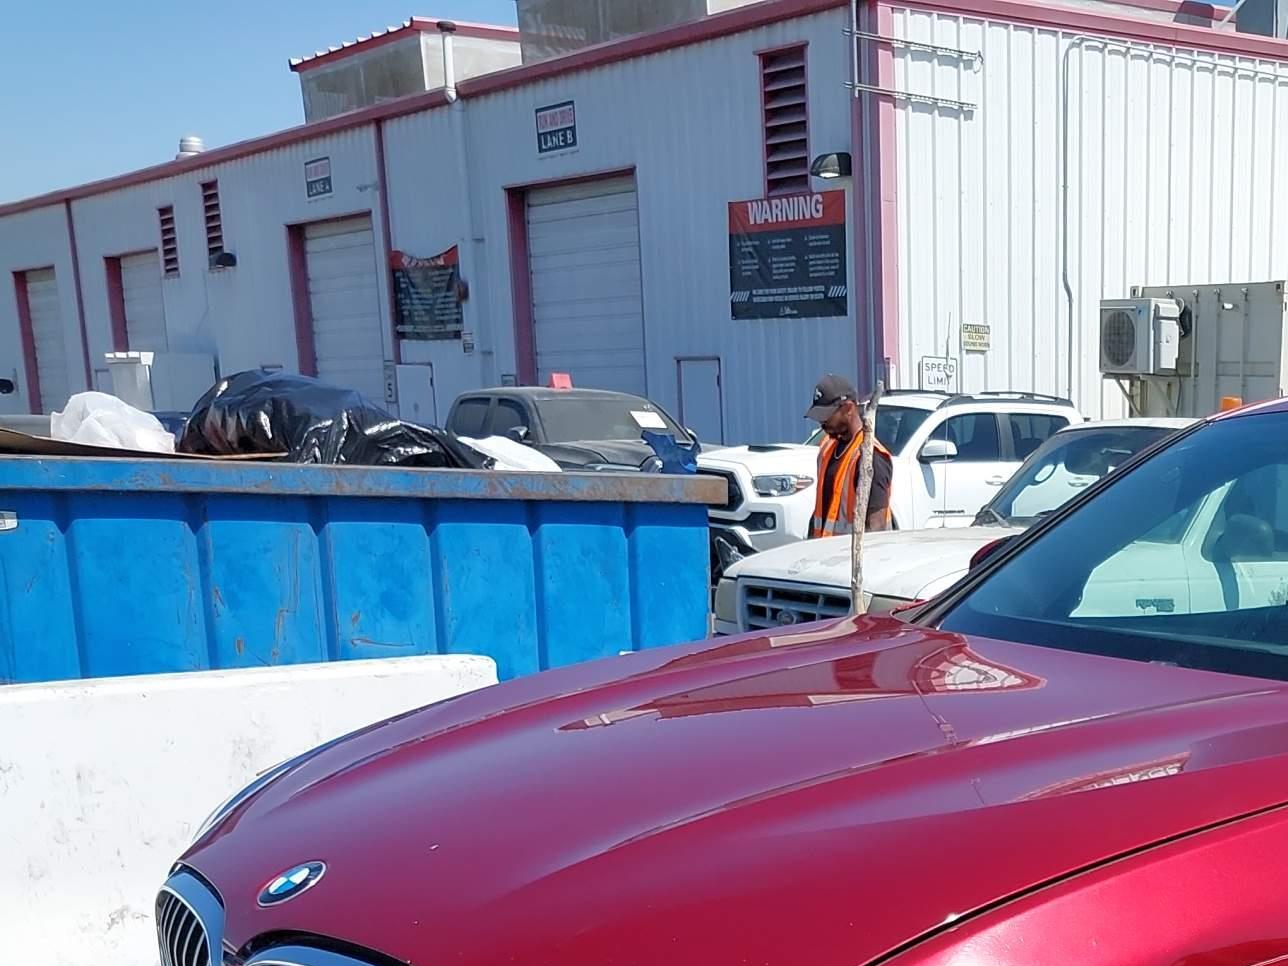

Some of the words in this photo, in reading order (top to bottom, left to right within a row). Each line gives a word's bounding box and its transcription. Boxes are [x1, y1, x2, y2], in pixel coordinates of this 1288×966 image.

[541, 131, 565, 149] LANE
[566, 130, 574, 144] B
[747, 194, 824, 225] WARNING
[963, 325, 990, 334] CAUTION
[967, 333, 985, 341] SLOW
[925, 362, 955, 373] SPEED
